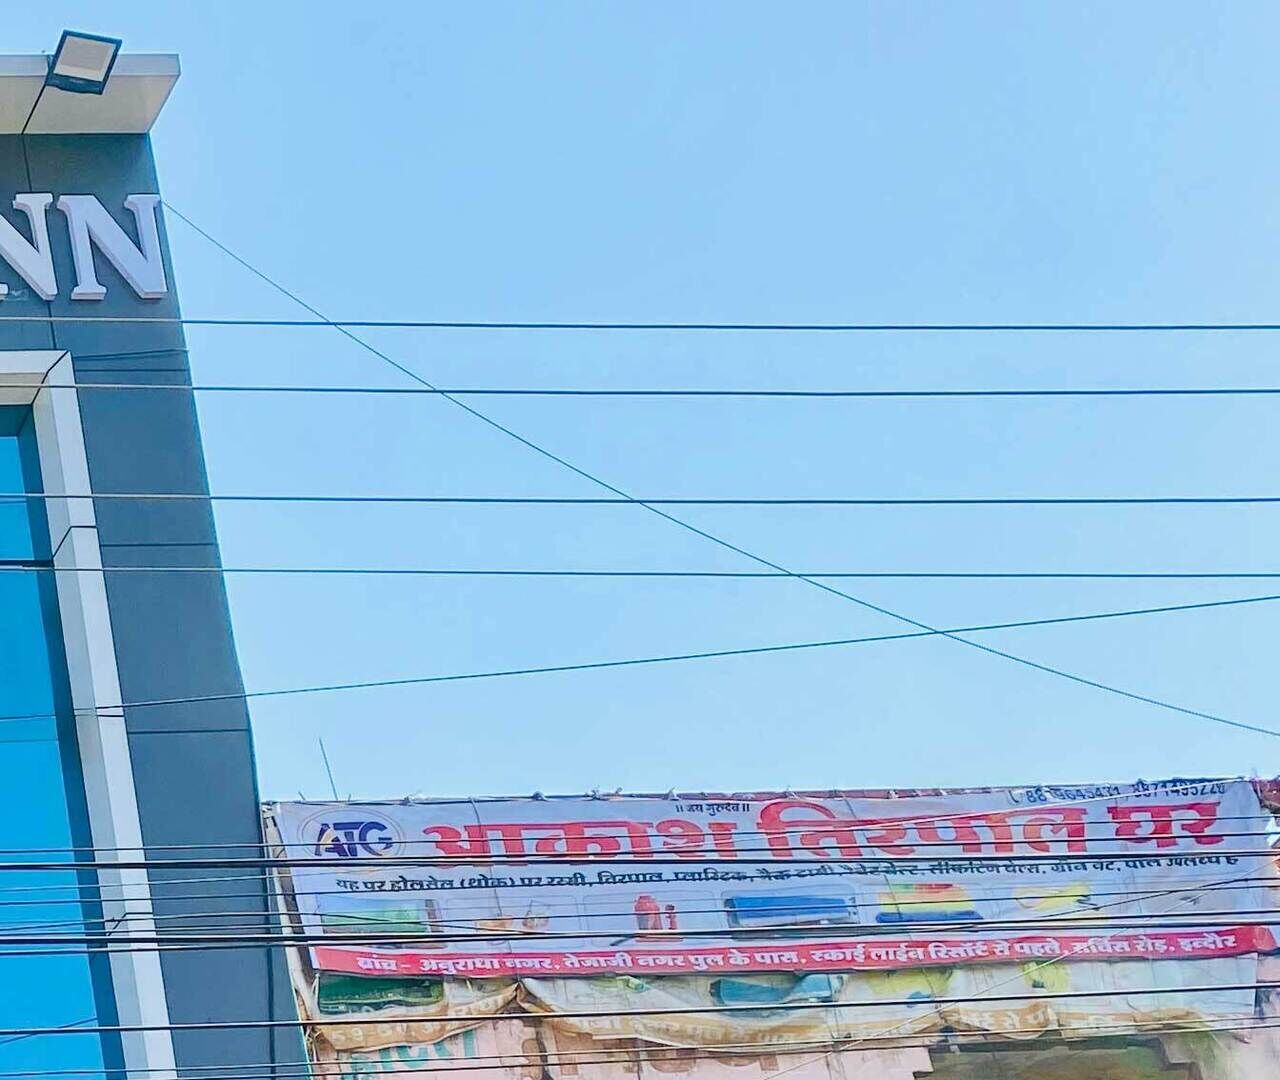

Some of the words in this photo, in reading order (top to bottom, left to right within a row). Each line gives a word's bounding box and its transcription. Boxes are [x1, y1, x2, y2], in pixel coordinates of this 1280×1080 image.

[424, 819, 740, 866] आकाश
[756, 800, 1088, 860] तिरपाल
[1107, 802, 1226, 848] घर
[691, 952, 724, 970] पुल
[728, 948, 750, 966] के
